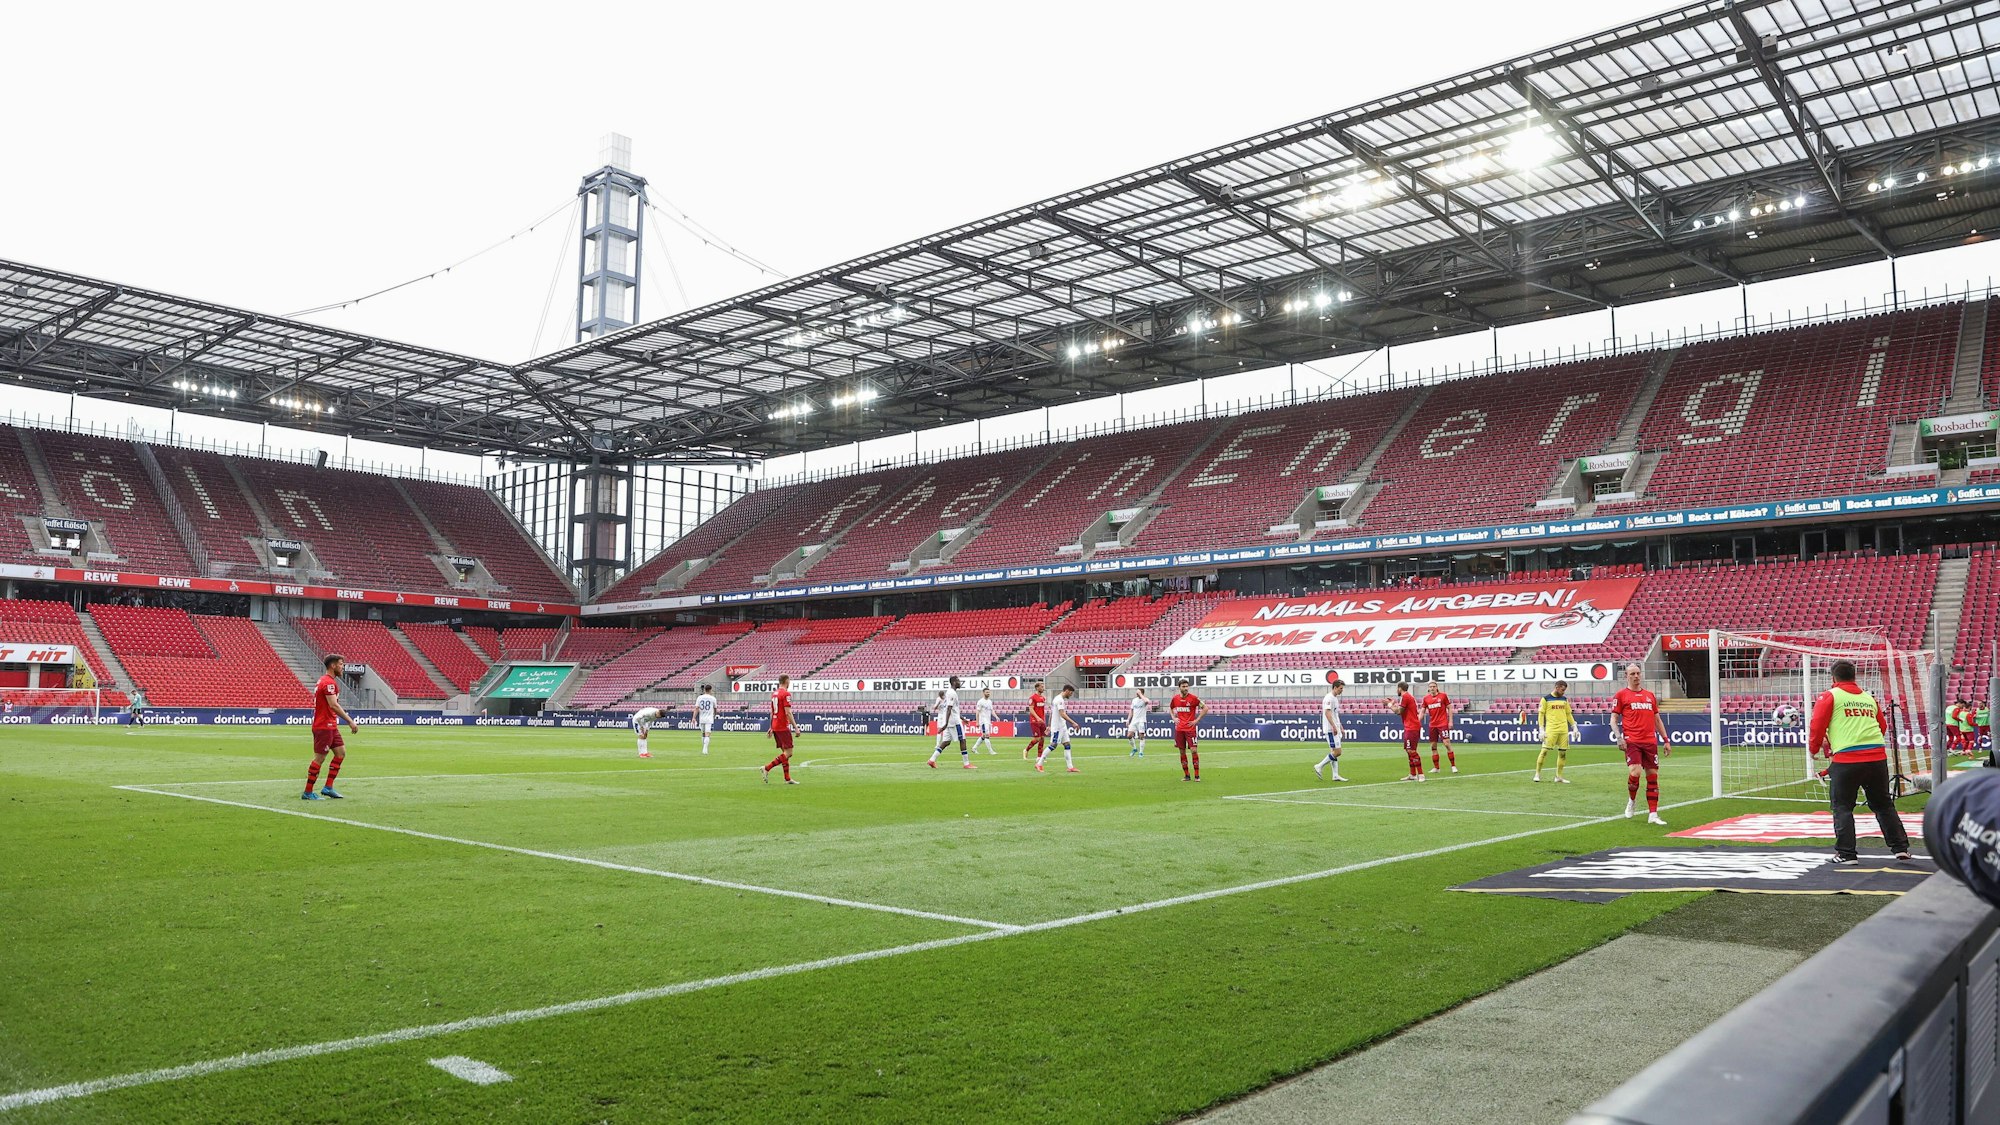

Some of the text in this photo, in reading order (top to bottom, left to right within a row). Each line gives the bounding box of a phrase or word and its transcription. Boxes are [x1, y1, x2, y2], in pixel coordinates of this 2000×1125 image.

[1933, 419, 1990, 433] Rosbacher
[1589, 458, 1630, 470] Rosbacher
[1958, 486, 1983, 499] Gaffel
[1846, 492, 1938, 510] Bock auf Kölsch?
[1784, 502, 1806, 513] Gaffel
[1688, 507, 1767, 522] Bock auf Kölsch?
[1550, 523, 1570, 534] Bock
[1586, 519, 1619, 531] Kölsch?
[84, 572, 118, 582] REWE
[159, 577, 190, 587] REWE
[275, 586, 304, 595] REWE
[337, 590, 364, 599] REWE
[435, 597, 458, 606] REWE
[488, 601, 511, 609] REWE
[1254, 588, 1578, 620] NIEMALS AUFGEBEN!
[1224, 622, 1534, 648] COME ON, EFFZEH!
[27, 650, 67, 661] HIT
[1134, 674, 1312, 687] BRÖTJE HEIZUNG
[1354, 668, 1578, 684] BRÖTJE HEIZUNG
[793, 681, 850, 690] HEIZUNG
[874, 679, 1001, 690] BRÖTJE HEZUNG
[700, 700, 710, 710] 38
[1845, 708, 1874, 718] REWE
[214, 715, 271, 724] dorint.com
[354, 716, 403, 724] dorint.com
[416, 716, 463, 725] dorint.com
[476, 717, 521, 726] dorint.com
[598, 719, 628, 727] dorint.com
[723, 721, 760, 730] dorint.com
[824, 722, 867, 732] dorint.com
[1196, 726, 1260, 738] orint.com
